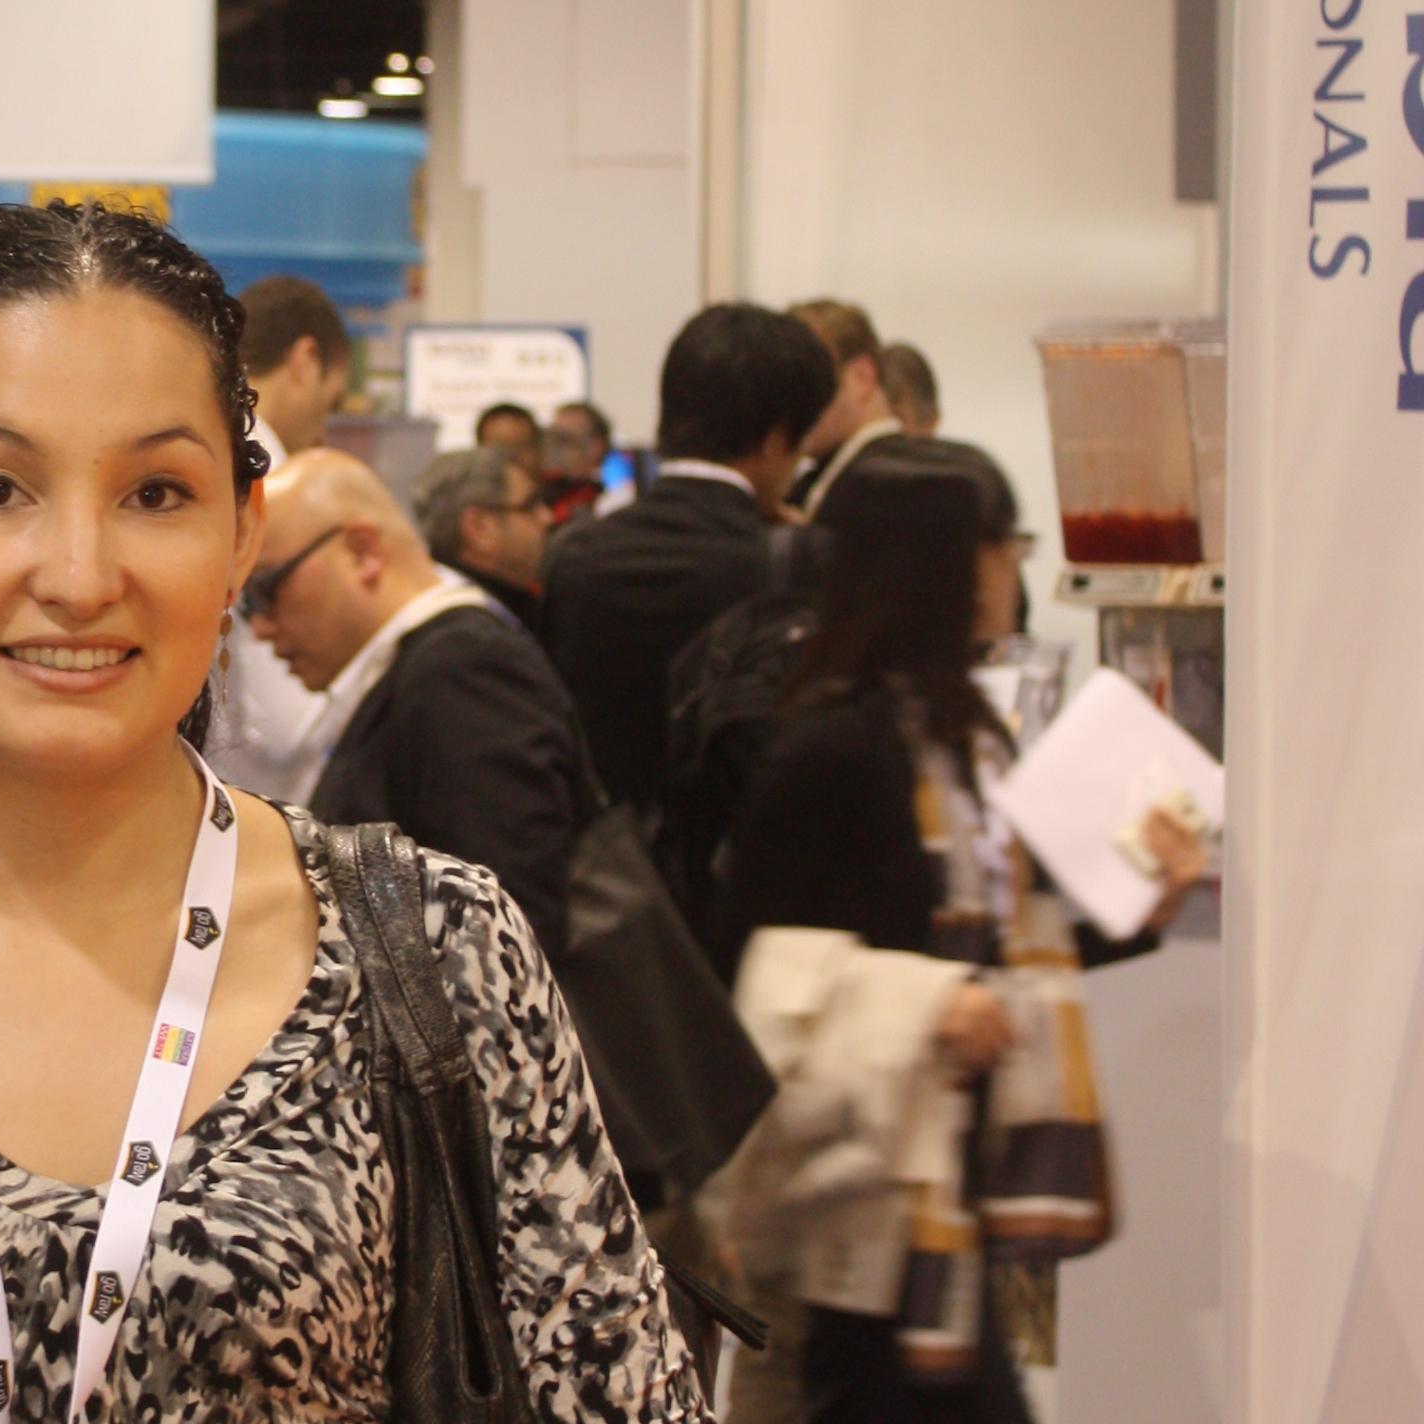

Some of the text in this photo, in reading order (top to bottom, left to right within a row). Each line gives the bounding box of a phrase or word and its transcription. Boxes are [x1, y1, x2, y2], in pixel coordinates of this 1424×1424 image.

[193, 910, 211, 925] go
[133, 1145, 152, 1161] go
[99, 1275, 117, 1294] go
